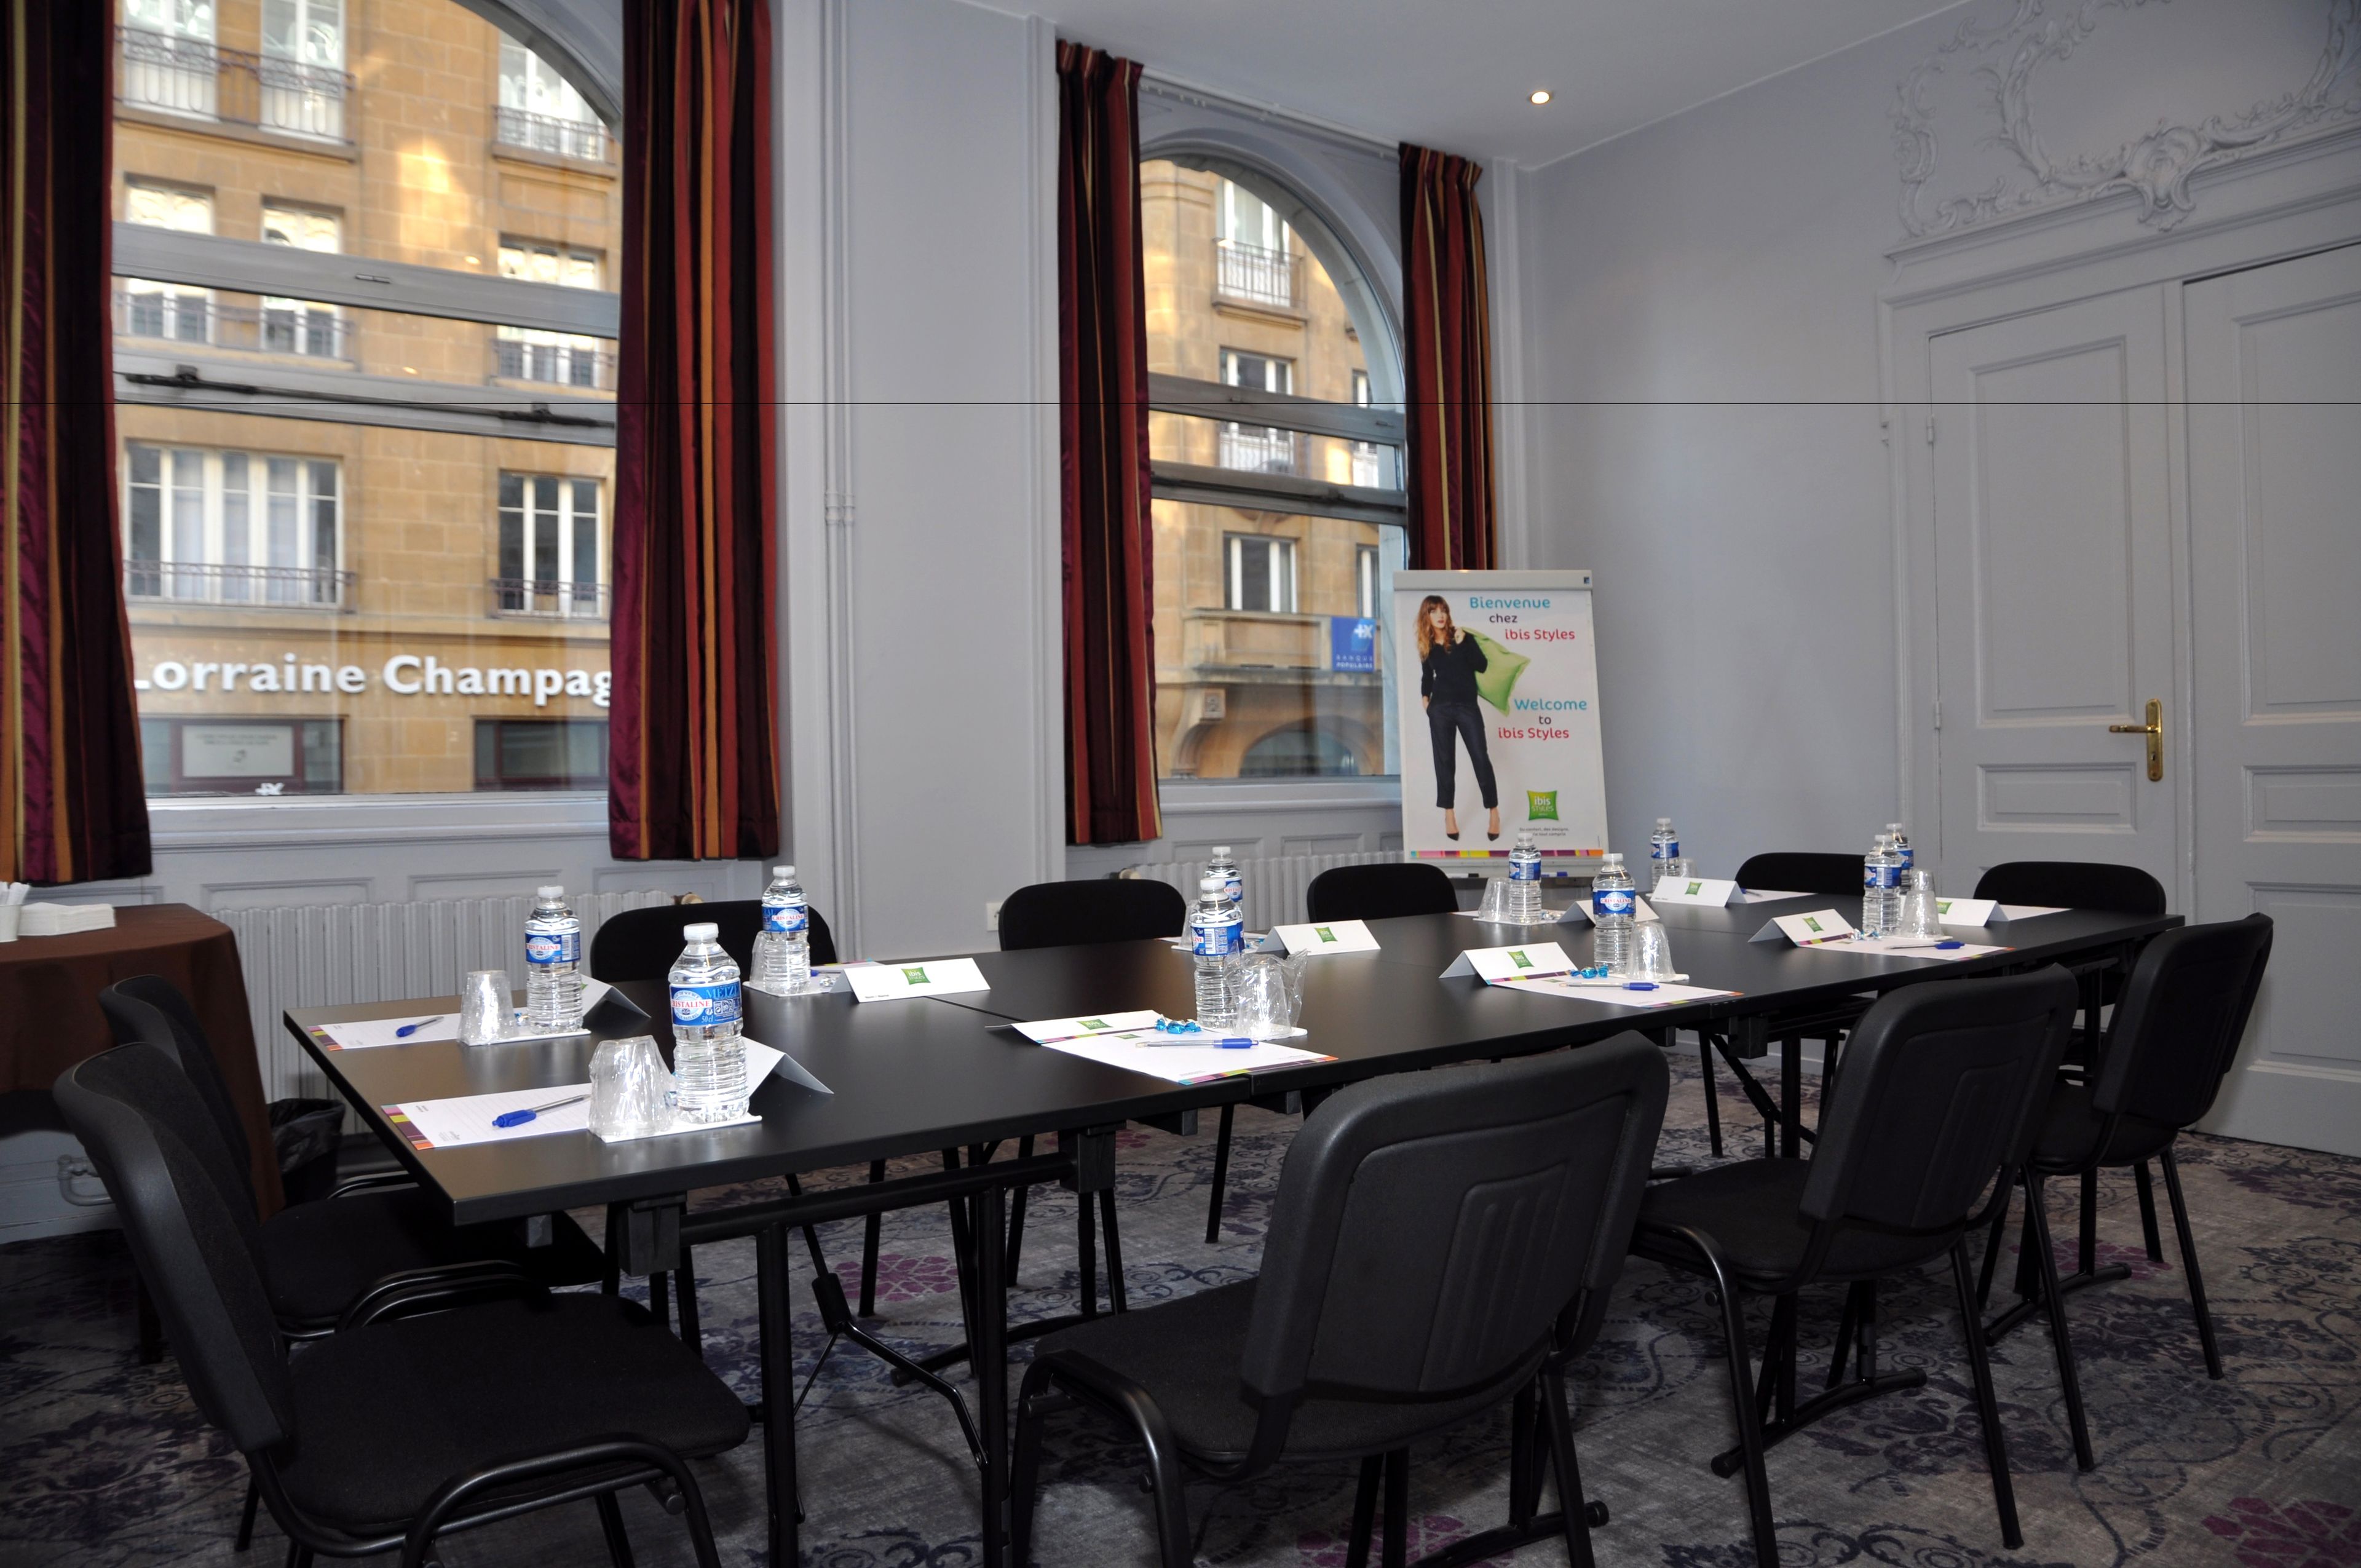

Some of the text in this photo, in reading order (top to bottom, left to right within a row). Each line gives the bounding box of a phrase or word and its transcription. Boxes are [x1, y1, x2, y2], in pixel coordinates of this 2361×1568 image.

[1469, 596, 1551, 608] Bienvenue
[1489, 614, 1518, 623] chez
[1505, 628, 1575, 641] ibis Styles
[1514, 699, 1588, 710] Welcome
[1538, 716, 1552, 724] to
[1498, 727, 1570, 740] ibis Styles
[1535, 796, 1551, 805] ibis
